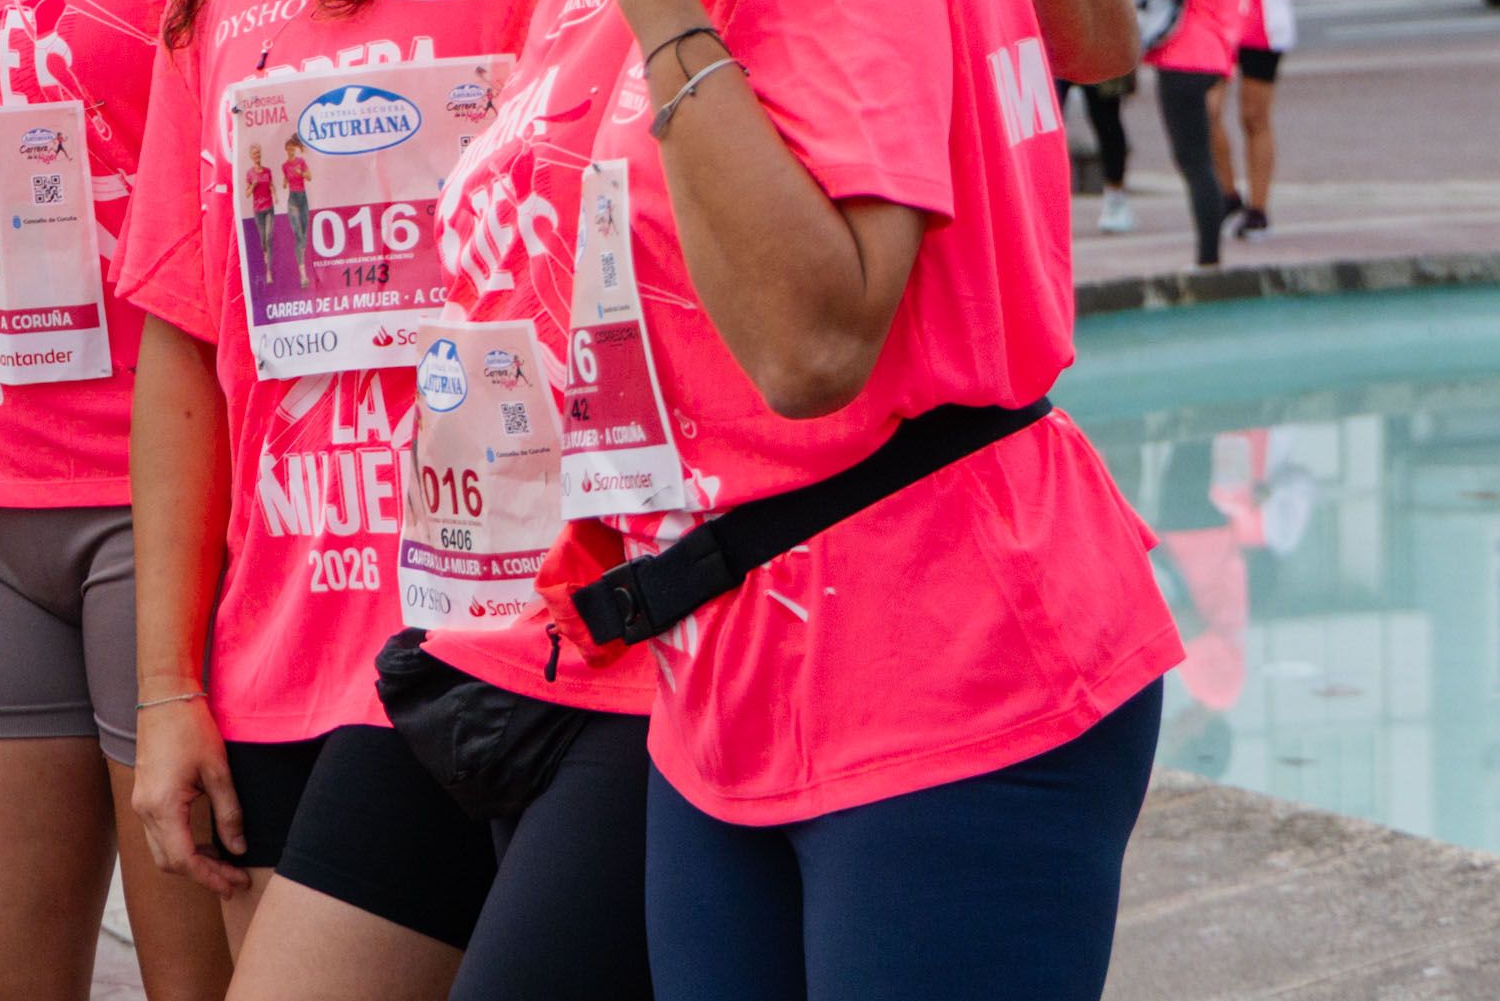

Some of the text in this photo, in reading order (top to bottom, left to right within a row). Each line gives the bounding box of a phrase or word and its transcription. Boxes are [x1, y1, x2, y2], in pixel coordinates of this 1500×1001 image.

[245, 106, 289, 127] SUMA
[308, 115, 411, 141] ASTURIANA
[312, 203, 419, 258] 016
[342, 263, 389, 288] 1143
[266, 299, 314, 319] CARRERA
[333, 295, 349, 310] LA
[353, 290, 400, 308] MUJER
[414, 288, 425, 304] A
[1, 316, 8, 330] A
[12, 310, 73, 330] CORUÑA
[273, 330, 338, 359] OYSHO
[605, 428, 612, 445] A
[422, 466, 483, 518] 016
[594, 473, 652, 491] Santander
[441, 528, 472, 550] 6406
[308, 546, 381, 592] 2026
[451, 558, 481, 576] MUJER
[491, 561, 501, 575] A
[407, 584, 451, 614] OYSHO
